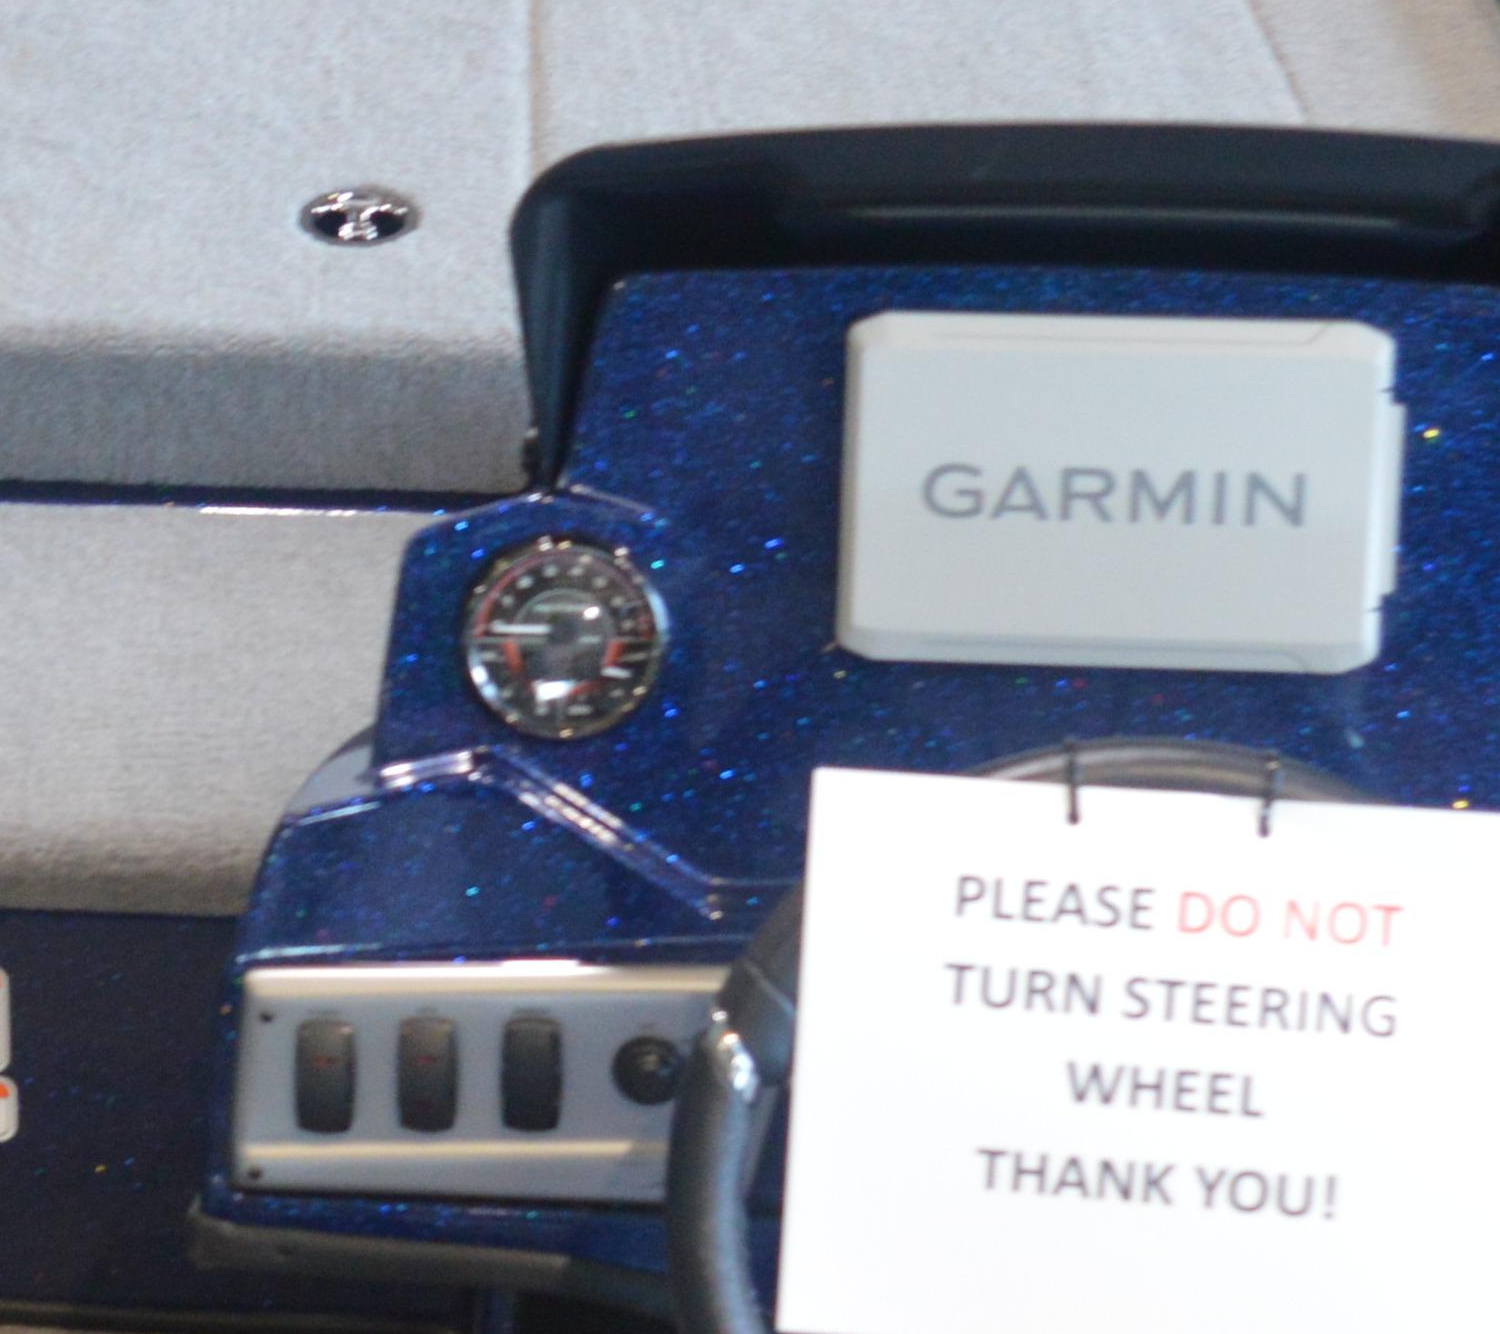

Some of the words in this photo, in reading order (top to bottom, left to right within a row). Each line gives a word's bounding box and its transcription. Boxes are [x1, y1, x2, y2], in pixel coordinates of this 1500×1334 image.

[922, 463, 1307, 527] GARMIN
[955, 875, 1156, 931] PLEASE
[1178, 891, 1262, 937] DO
[1283, 899, 1404, 947] NOT
[945, 963, 1102, 1016] TURN
[1122, 976, 1398, 1038] STEERING
[1066, 1061, 1264, 1118] WHEEL
[976, 1147, 1176, 1206] THANK
[1194, 1166, 1339, 1220] YOU!
